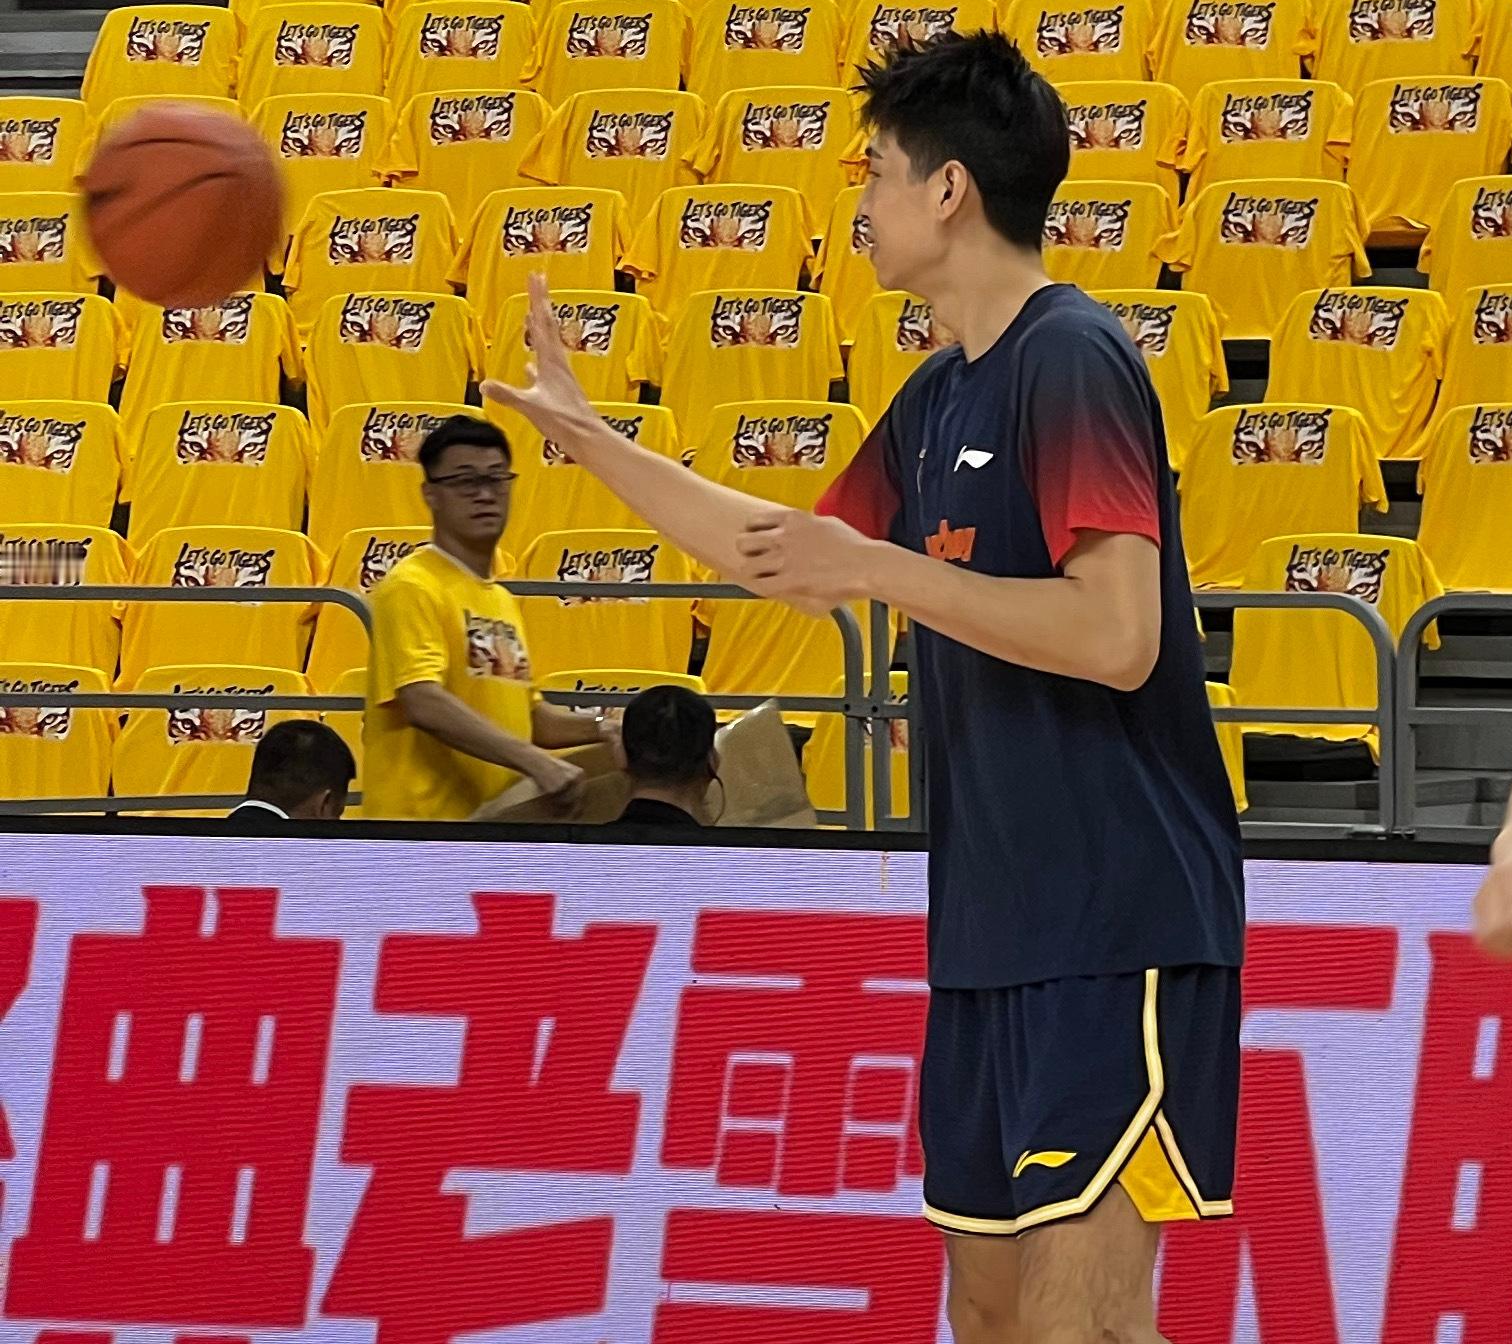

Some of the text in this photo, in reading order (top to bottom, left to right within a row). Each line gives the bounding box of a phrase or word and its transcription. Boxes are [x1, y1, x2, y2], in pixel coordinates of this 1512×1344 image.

[127, 16, 210, 41] LET'S GO TIGERS
[420, 12, 505, 35] LET'S GO TIGERS
[1221, 90, 1314, 116] LET'S GO TIGERS
[281, 110, 367, 132] LET'S GO TIGERS
[681, 198, 772, 223] LET'S GO TIGERS
[1222, 192, 1318, 220] LET'S GO TIGERS
[1472, 187, 1505, 210] LET'S
[329, 214, 419, 237] LET'S GO TIGERS
[503, 203, 593, 229] LET'S GO TIGERS
[341, 291, 434, 323] LET'S GO TIGERS
[710, 295, 805, 319] LET'S GO TIGERS
[1313, 287, 1409, 321] LET'S GO TIGERS
[177, 410, 276, 436] LET'S GO TIGERS
[733, 413, 832, 439] LET'S GO TIGERS
[1233, 408, 1332, 434] LET'S GO TIGERS
